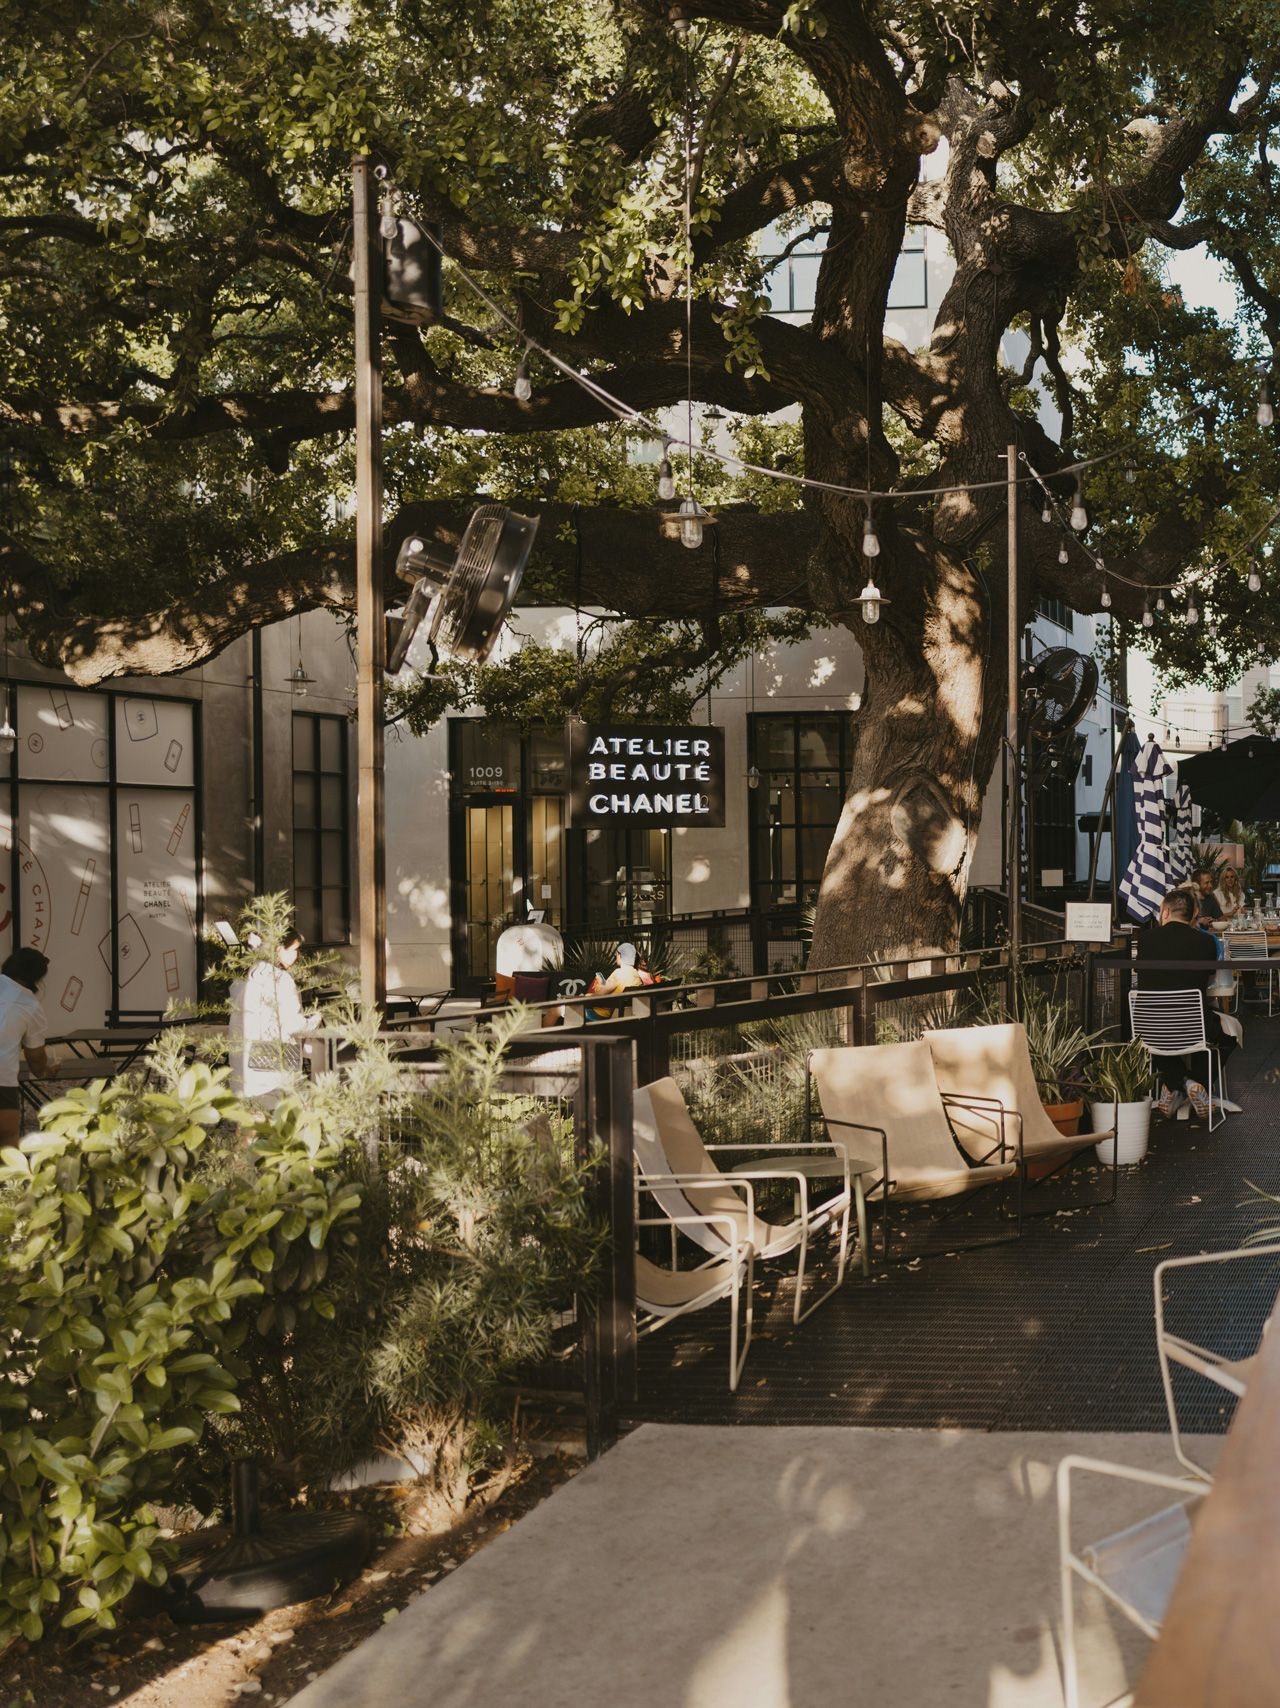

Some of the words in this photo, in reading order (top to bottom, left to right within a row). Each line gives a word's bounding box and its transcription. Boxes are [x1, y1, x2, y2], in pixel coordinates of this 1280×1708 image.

[588, 736, 710, 757] ATELIER
[470, 766, 503, 778] 1009
[588, 761, 710, 781] BEAUTÉ
[589, 793, 710, 814] CHANEL
[143, 900, 171, 908] CHANEL
[30, 884, 44, 947] CHAN
